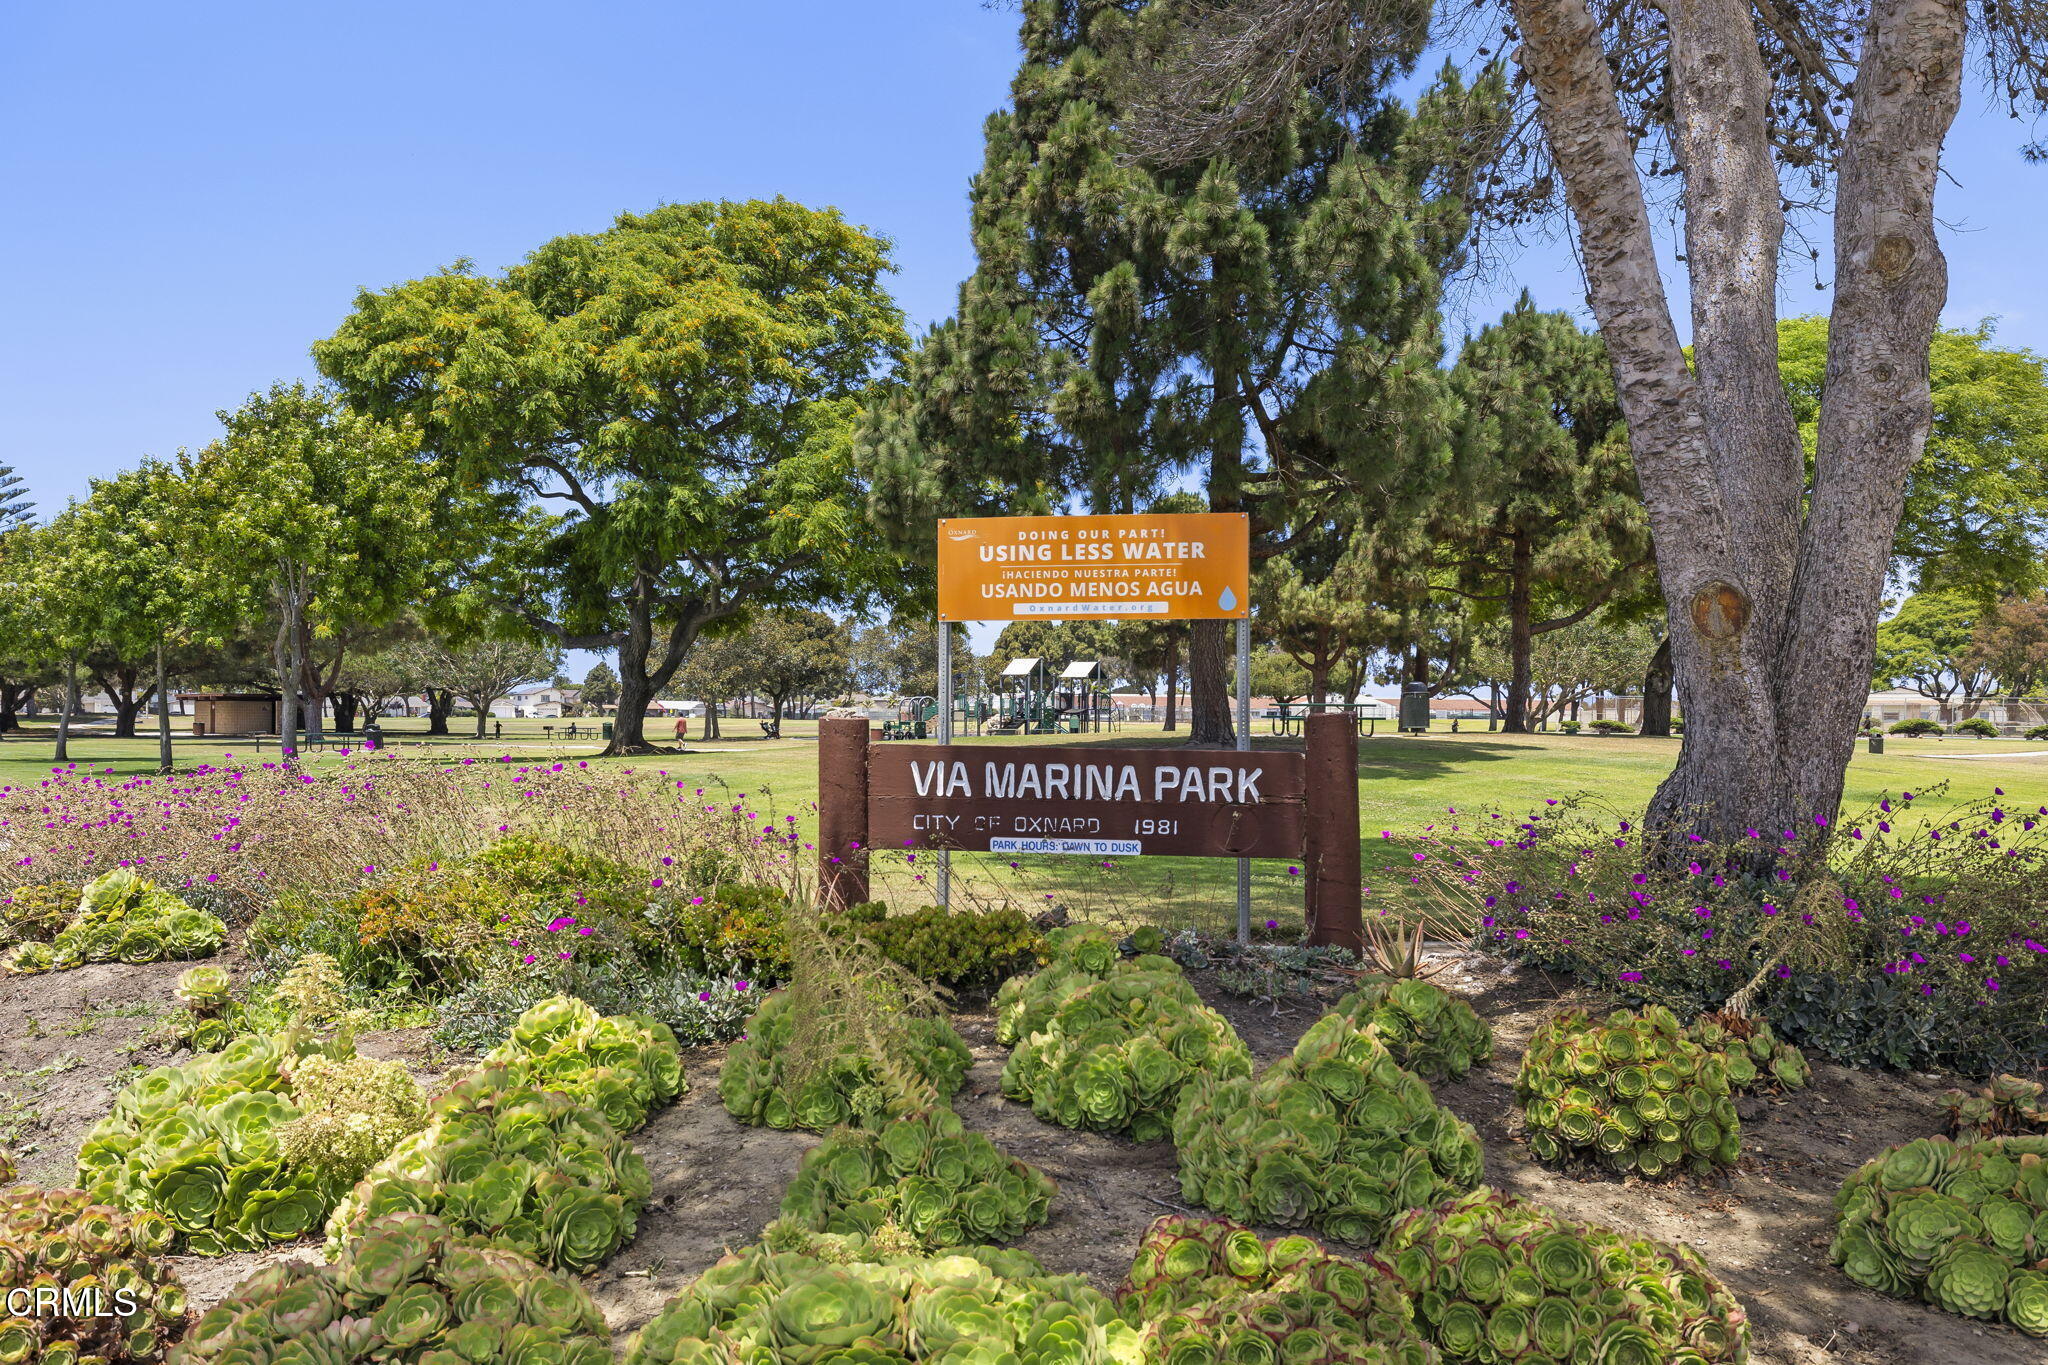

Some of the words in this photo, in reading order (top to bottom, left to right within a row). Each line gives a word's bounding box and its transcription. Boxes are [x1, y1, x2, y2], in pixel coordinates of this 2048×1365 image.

[1018, 530, 1069, 541] DOING
[1078, 529, 1110, 539] OUR
[1119, 528, 1166, 539] PART!
[979, 545, 1051, 562] USING
[1061, 543, 1114, 561] LESS
[1122, 541, 1206, 560] WATER
[1074, 569, 1129, 578] NUESTRA
[1134, 568, 1177, 577] PARTE!
[981, 583, 1063, 599] USANDO
[1070, 581, 1140, 597] MENOS
[1146, 580, 1203, 596] AGUA
[1029, 603, 1154, 613] OxnardWater.org
[910, 760, 972, 798] VIA
[984, 762, 1141, 802] MARINA
[1154, 765, 1264, 804] PARK
[913, 814, 960, 830] CITY
[1014, 816, 1100, 833] OXNARD
[1134, 819, 1178, 835] 1981
[992, 840, 1018, 851] PARK
[1021, 840, 1059, 852] HOURS:
[1062, 841, 1091, 852] DAWN
[1094, 842, 1108, 852] TO
[1111, 842, 1139, 853] DUSK
